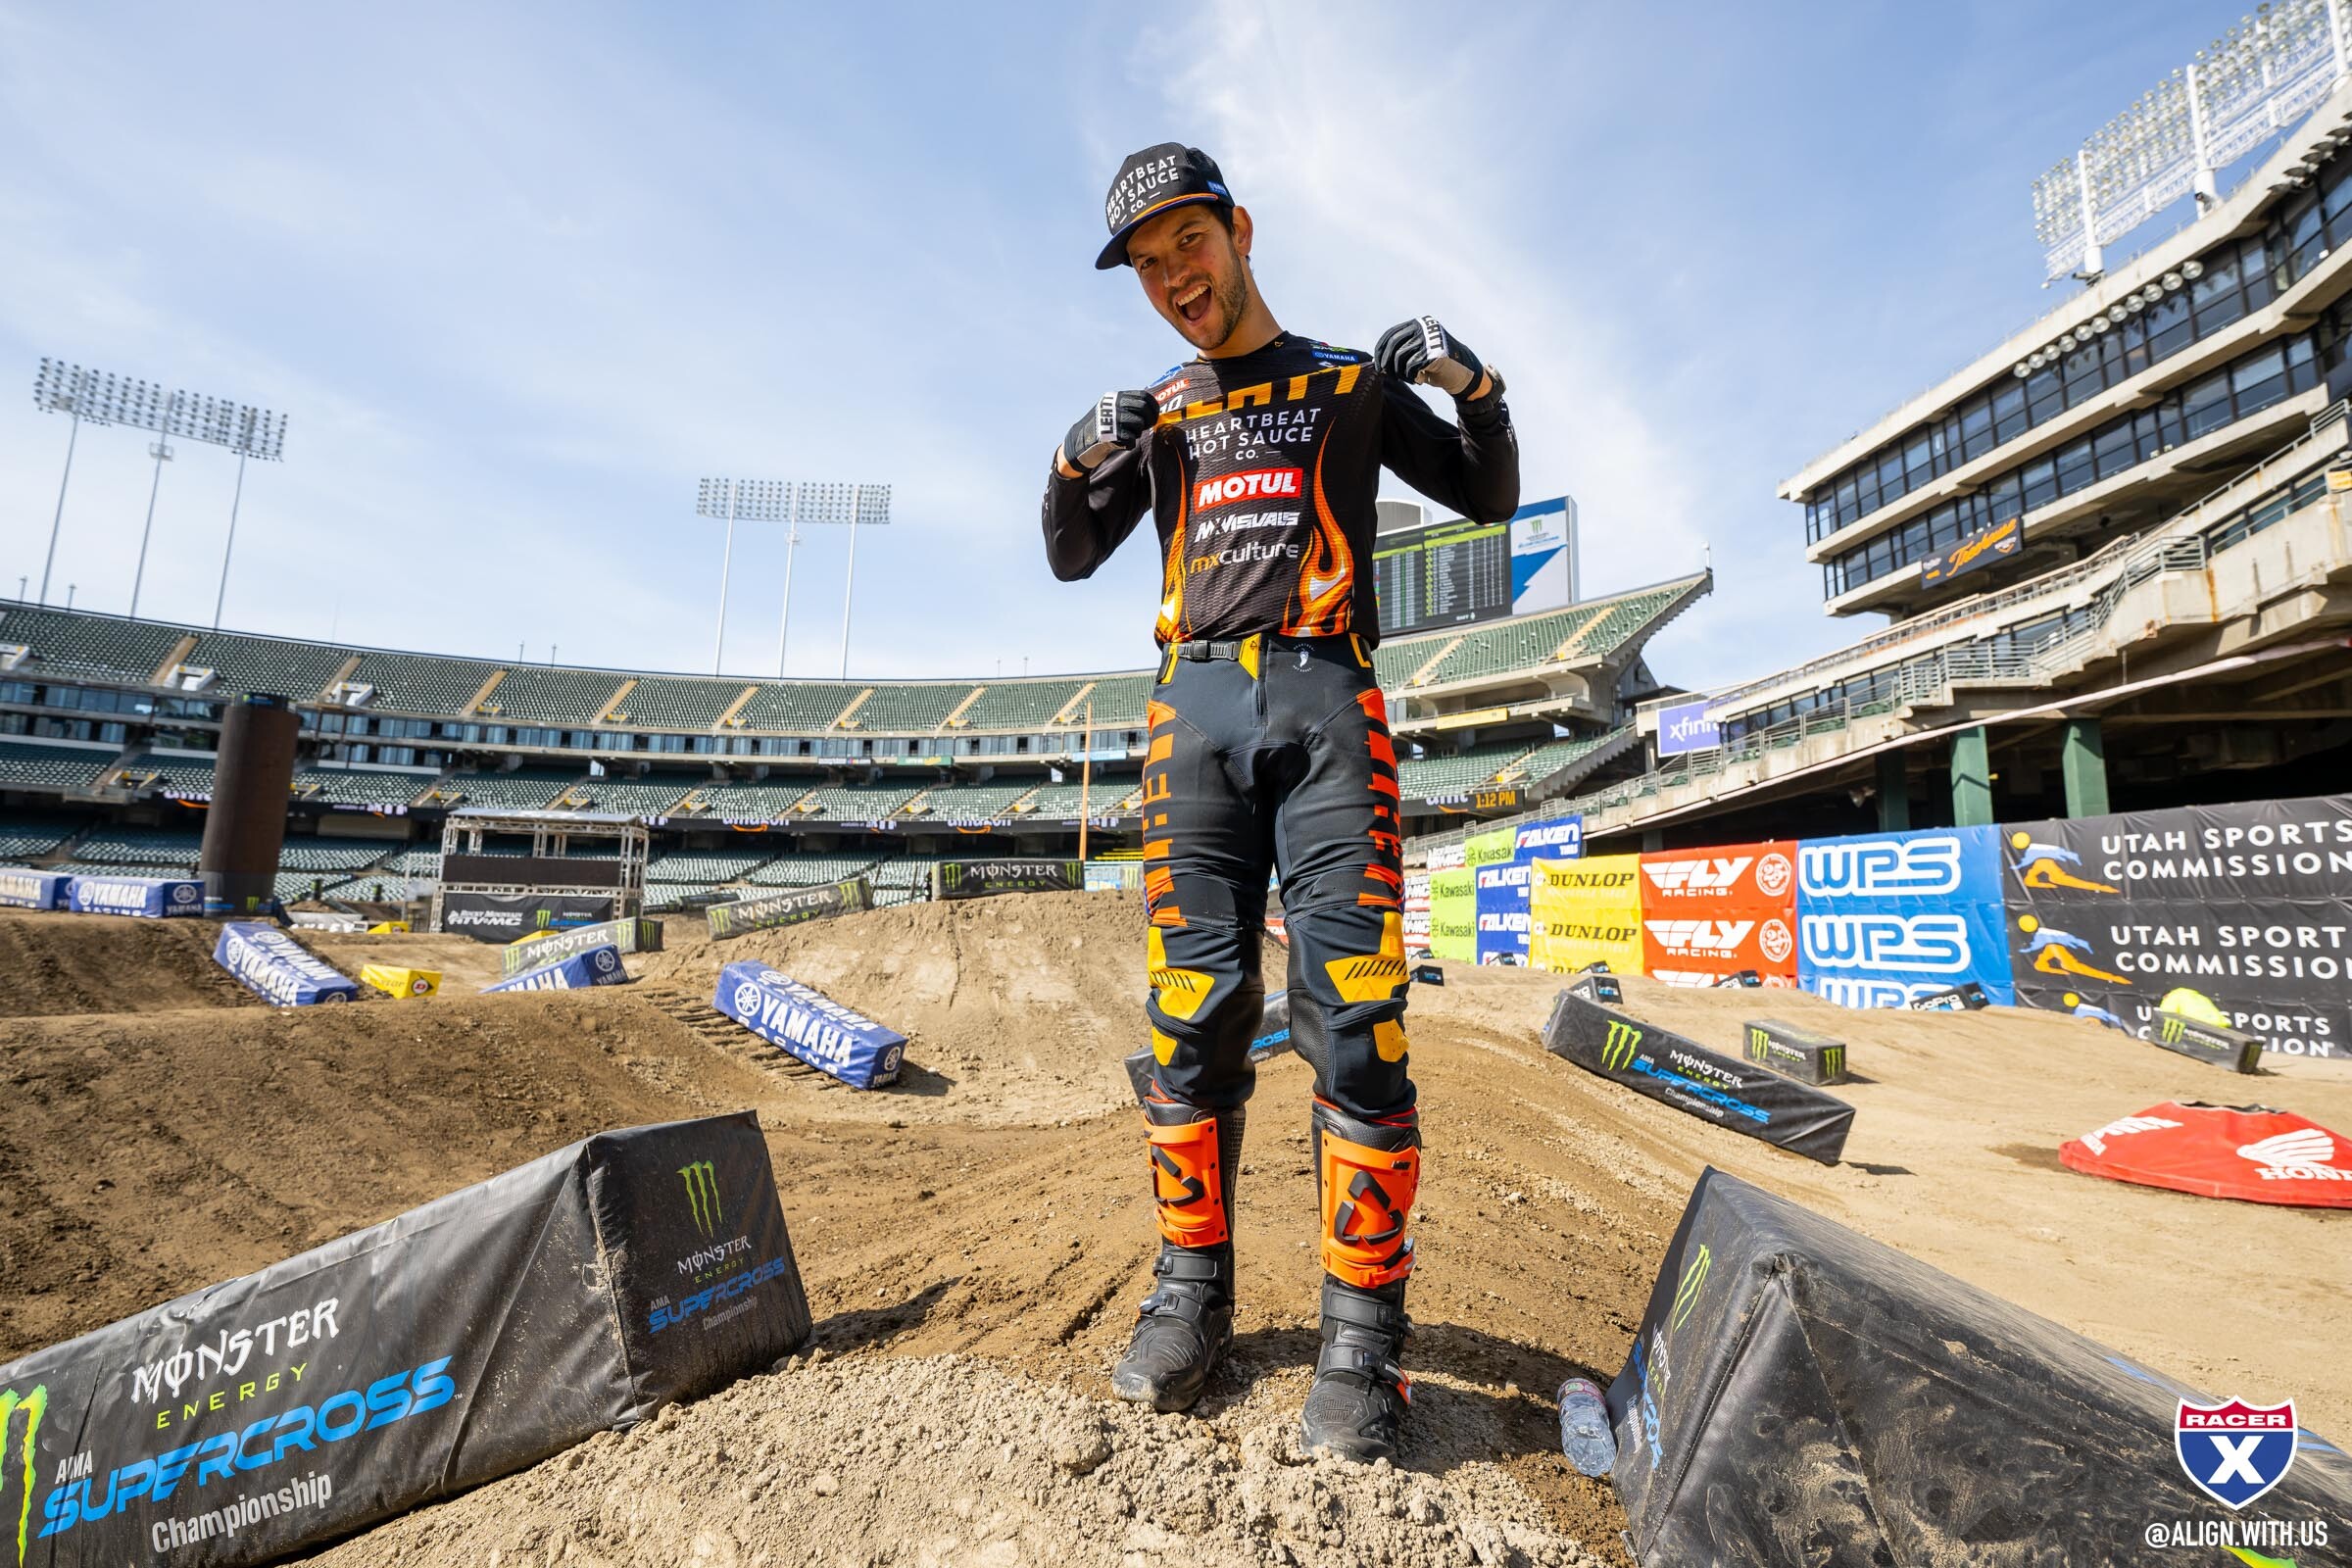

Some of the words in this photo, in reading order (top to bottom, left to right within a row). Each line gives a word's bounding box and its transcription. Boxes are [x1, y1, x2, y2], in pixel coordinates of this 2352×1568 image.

[1106, 155, 1176, 217] HEARTBEAT
[1109, 198, 1126, 228] HOT
[1128, 168, 1179, 203] SAUCE
[1130, 199, 1147, 214] CO.
[1324, 353, 1355, 362] YAMAHA
[1156, 379, 1187, 402] OTUL
[1186, 408, 1321, 443] HEARTBEAT
[1189, 435, 1231, 461] HOT
[1238, 426, 1313, 447] SAUCE
[1235, 449, 1259, 461] CO.
[1199, 472, 1297, 508] MOTUL
[1475, 791, 1496, 808] 1:12
[1498, 790, 1516, 807] PM
[1516, 823, 1580, 850] FALKEN
[2101, 831, 2187, 855] UTAH
[2204, 819, 2352, 850] SPORTS
[970, 862, 1058, 879] MONSTER
[1550, 873, 1635, 887] DUNLOP
[1641, 857, 1754, 889] FLY
[1799, 836, 1961, 897] WPS
[2103, 851, 2352, 880] COMMISSION
[93, 883, 147, 908] YAMAHA
[736, 889, 833, 919] MONSTER
[1441, 880, 1475, 899] Kawasaki
[1662, 888, 1727, 897] RACING
[526, 929, 611, 958] MONSTER
[1441, 921, 1475, 938] Kawasaki
[1550, 924, 1637, 941] DUNLOP
[1643, 919, 1755, 949] FLY
[1801, 914, 1971, 974] WPS
[2111, 925, 2200, 946] UTAH
[1666, 948, 1732, 957] RACING
[737, 1014, 839, 1075] RACING
[760, 993, 854, 1068] YAMAHA
[1639, 1054, 1655, 1064] AMA
[1768, 1039, 1807, 1060] MONSTER
[1669, 1049, 1743, 1089] MONSTER
[1677, 1065, 1730, 1091] ENERGY
[1631, 1058, 1772, 1124] SUPERCROSS
[1665, 1087, 1725, 1118] Championship
[676, 1235, 753, 1274] MONSTER
[694, 1256, 745, 1284] ENERGY
[648, 1256, 785, 1334] SUPERCROSS
[650, 1295, 671, 1311] AMA
[703, 1295, 759, 1331] Championship
[130, 1297, 340, 1404] MONSTER
[157, 1363, 308, 1430] ENERGY
[37, 1355, 455, 1540] SUPERCROSS
[55, 1449, 94, 1485] AMA
[151, 1471, 333, 1553] Championship
